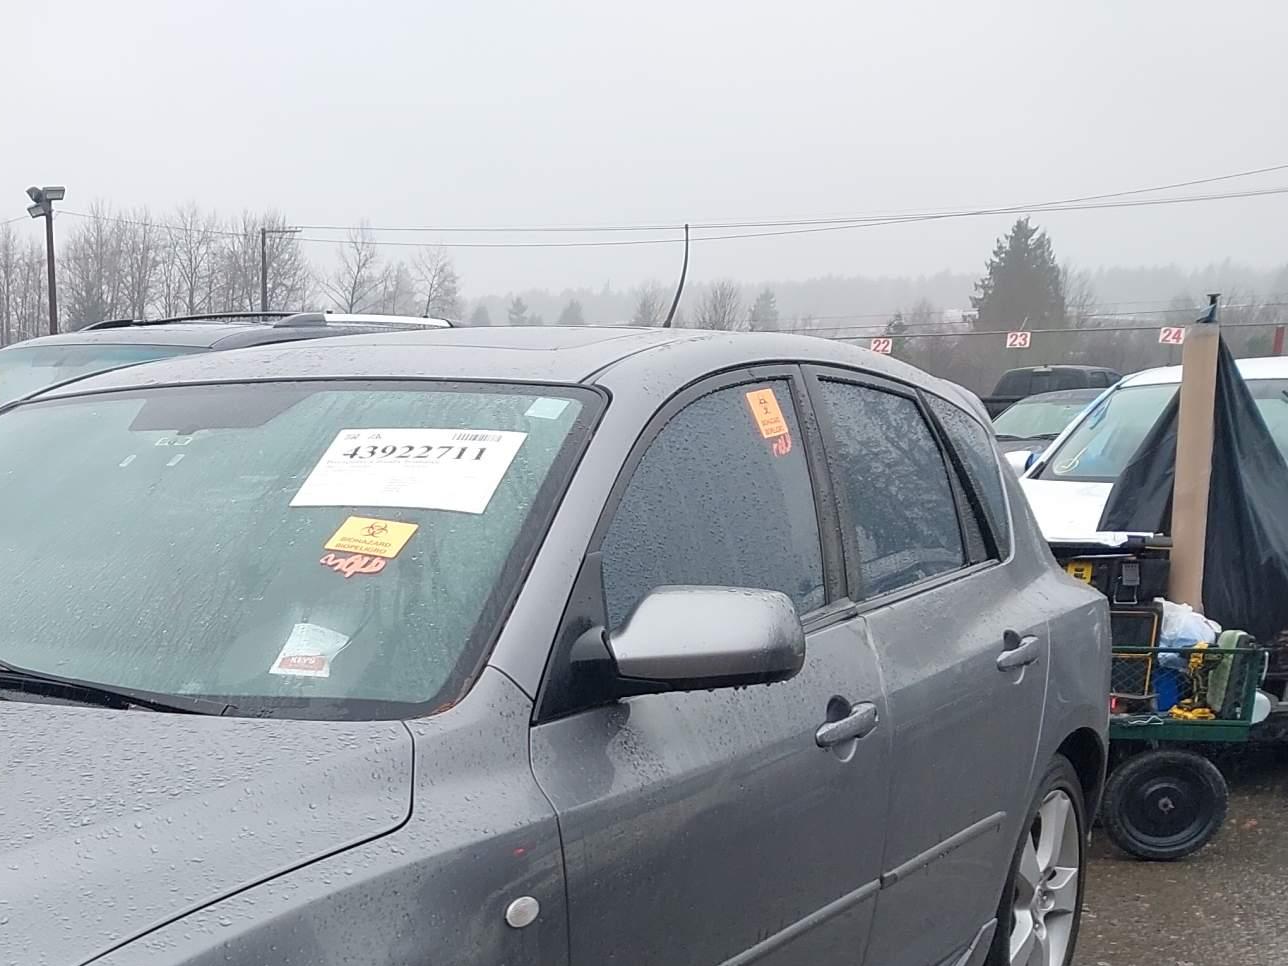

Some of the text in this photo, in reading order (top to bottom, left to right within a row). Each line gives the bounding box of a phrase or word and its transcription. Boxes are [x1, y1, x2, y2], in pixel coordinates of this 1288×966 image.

[1009, 333, 1028, 347] 23
[1162, 328, 1182, 343] 24
[873, 339, 890, 353] 22
[342, 444, 488, 461] 43922711
[339, 536, 392, 548] BIOHAZARD
